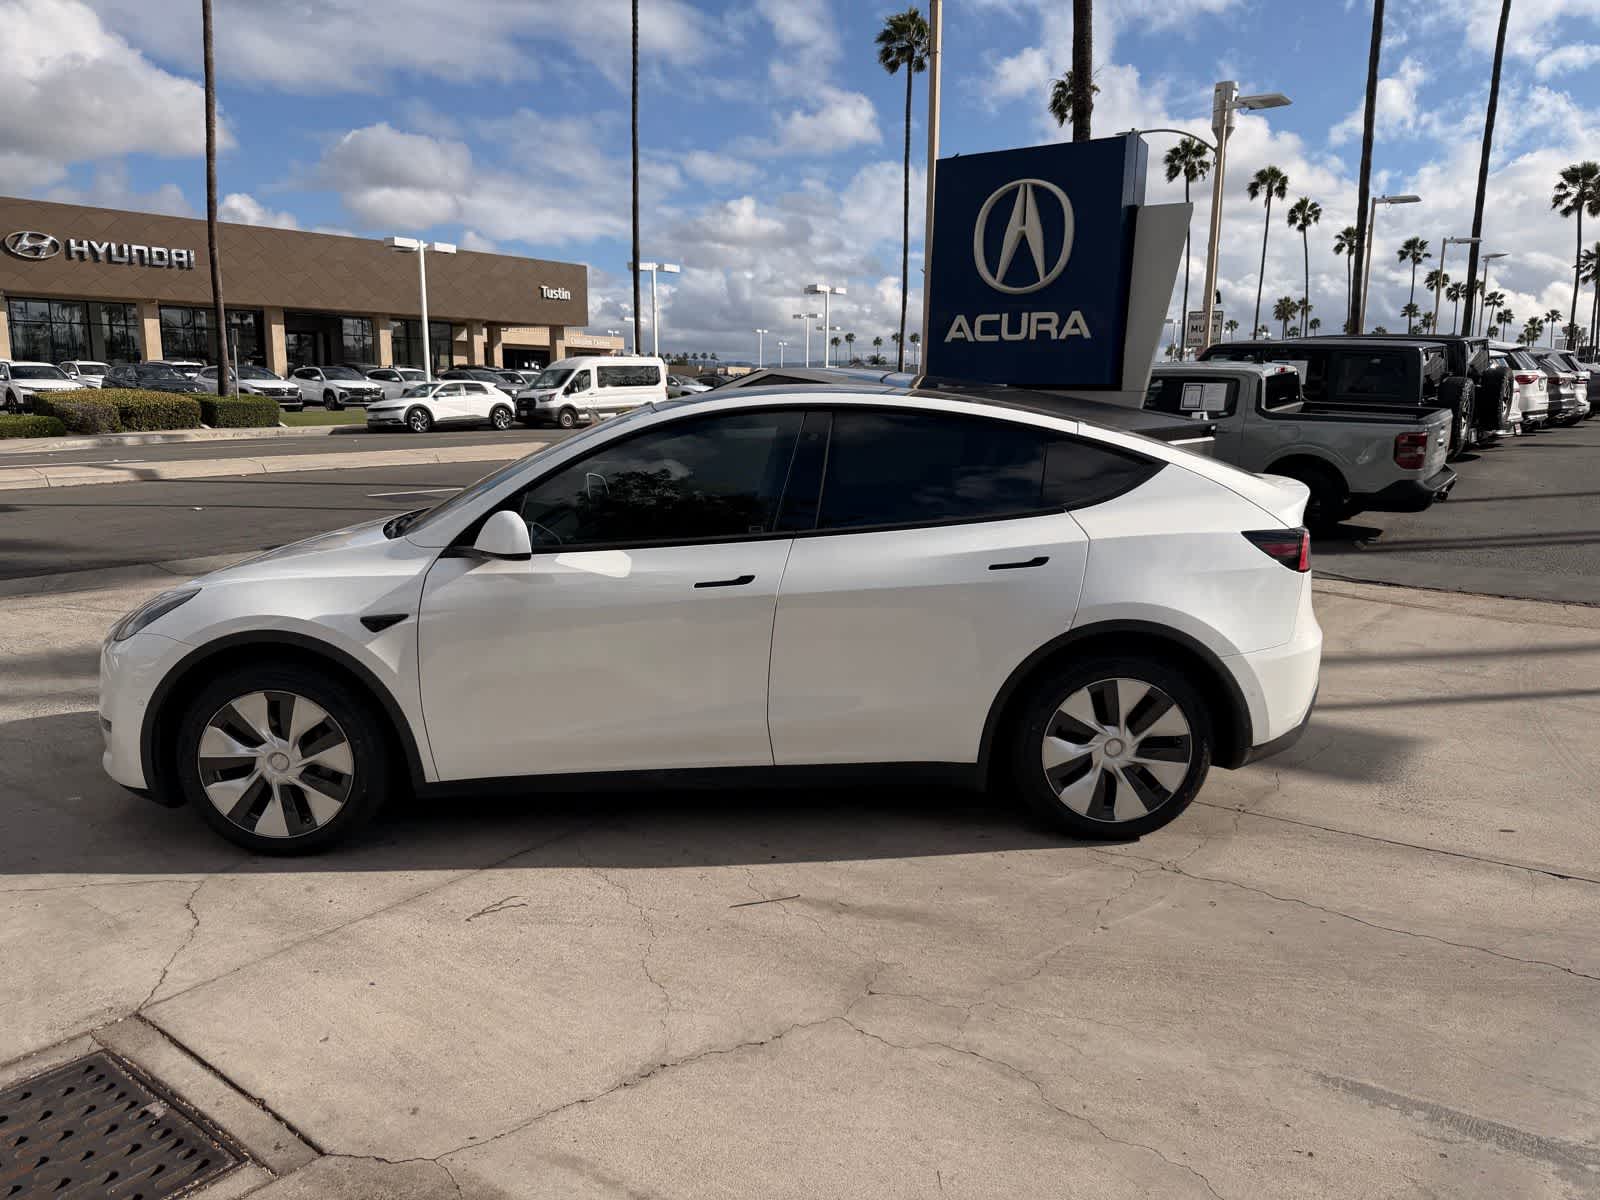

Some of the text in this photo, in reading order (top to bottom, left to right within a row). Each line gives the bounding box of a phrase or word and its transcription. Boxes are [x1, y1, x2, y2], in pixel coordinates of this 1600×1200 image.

[67, 238, 196, 269] HYUNDAI
[540, 285, 571, 300] Tustin
[944, 310, 1092, 343] ACURA
[1191, 324, 1218, 333] MUT
